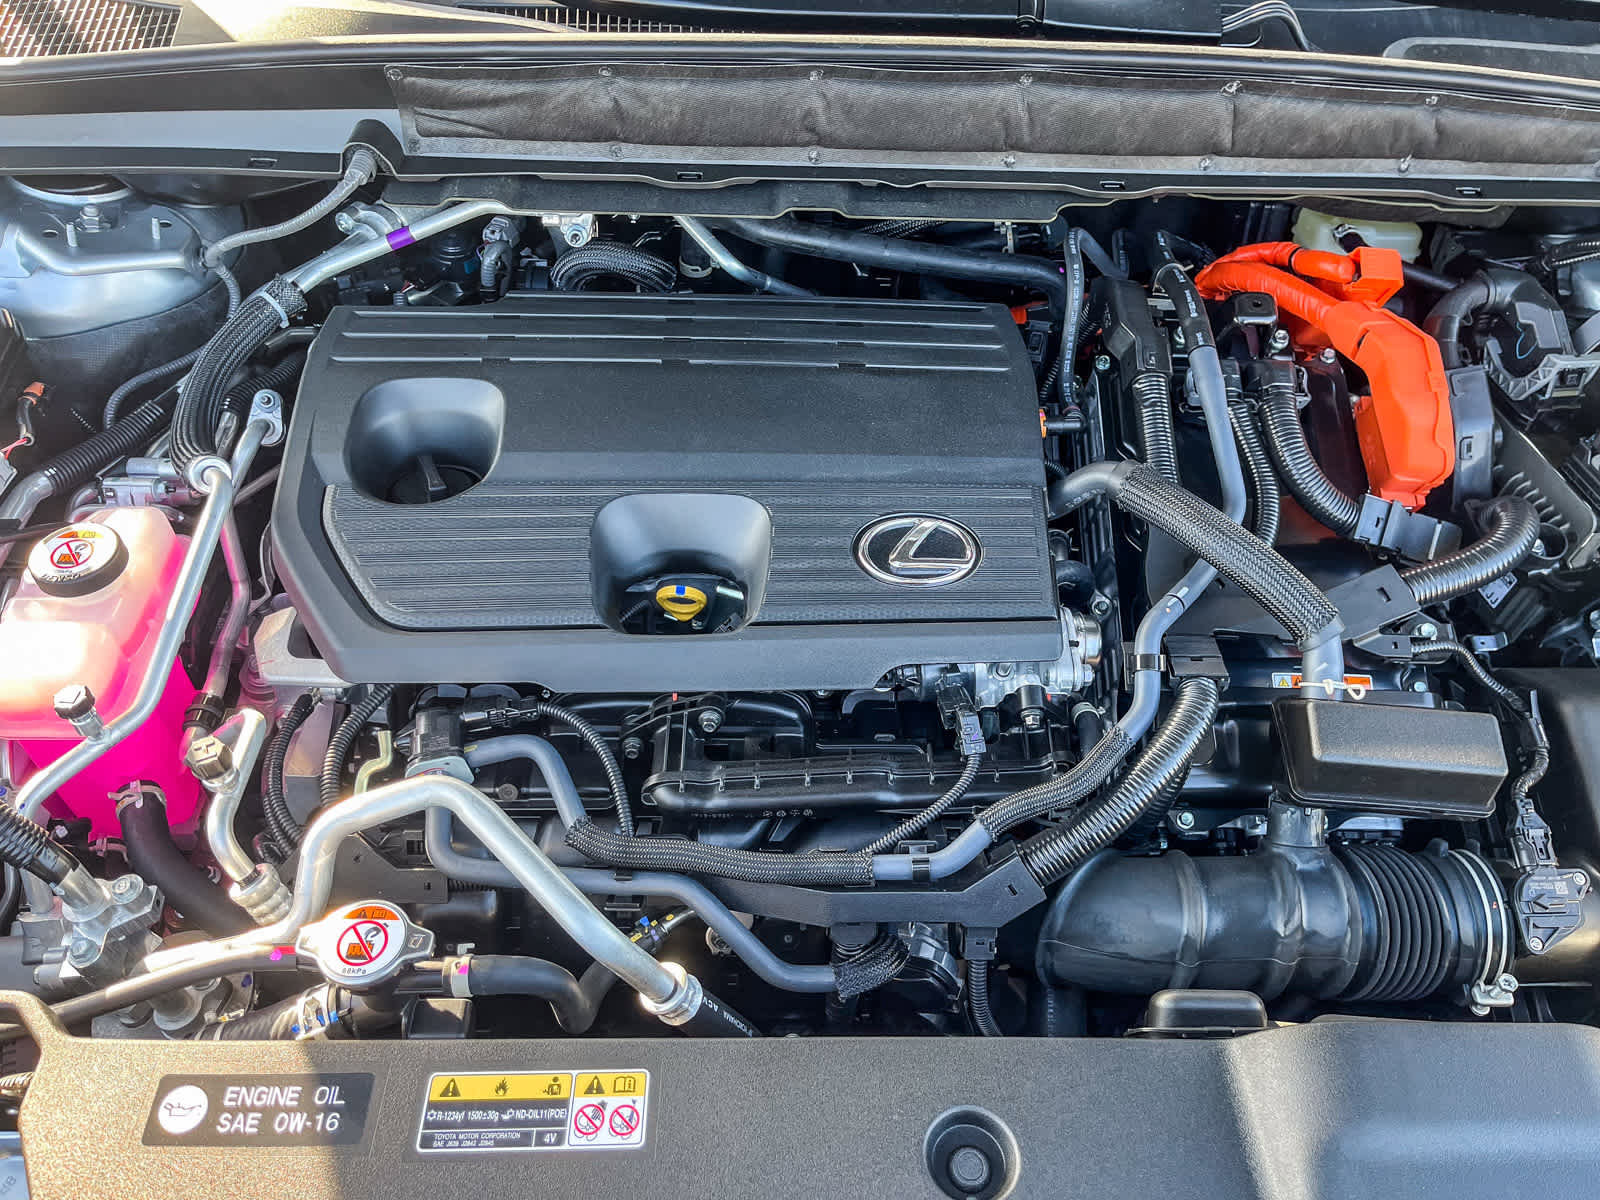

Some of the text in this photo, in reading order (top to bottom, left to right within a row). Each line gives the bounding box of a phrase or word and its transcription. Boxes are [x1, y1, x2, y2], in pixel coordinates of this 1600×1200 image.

[222, 1085, 345, 1107] ENGINE OIL
[215, 1111, 341, 1133] SAE 0W-16
[458, 1132, 479, 1140] MOTOR
[480, 1131, 521, 1139] CORPORATION
[543, 1132, 558, 1144] 4V
